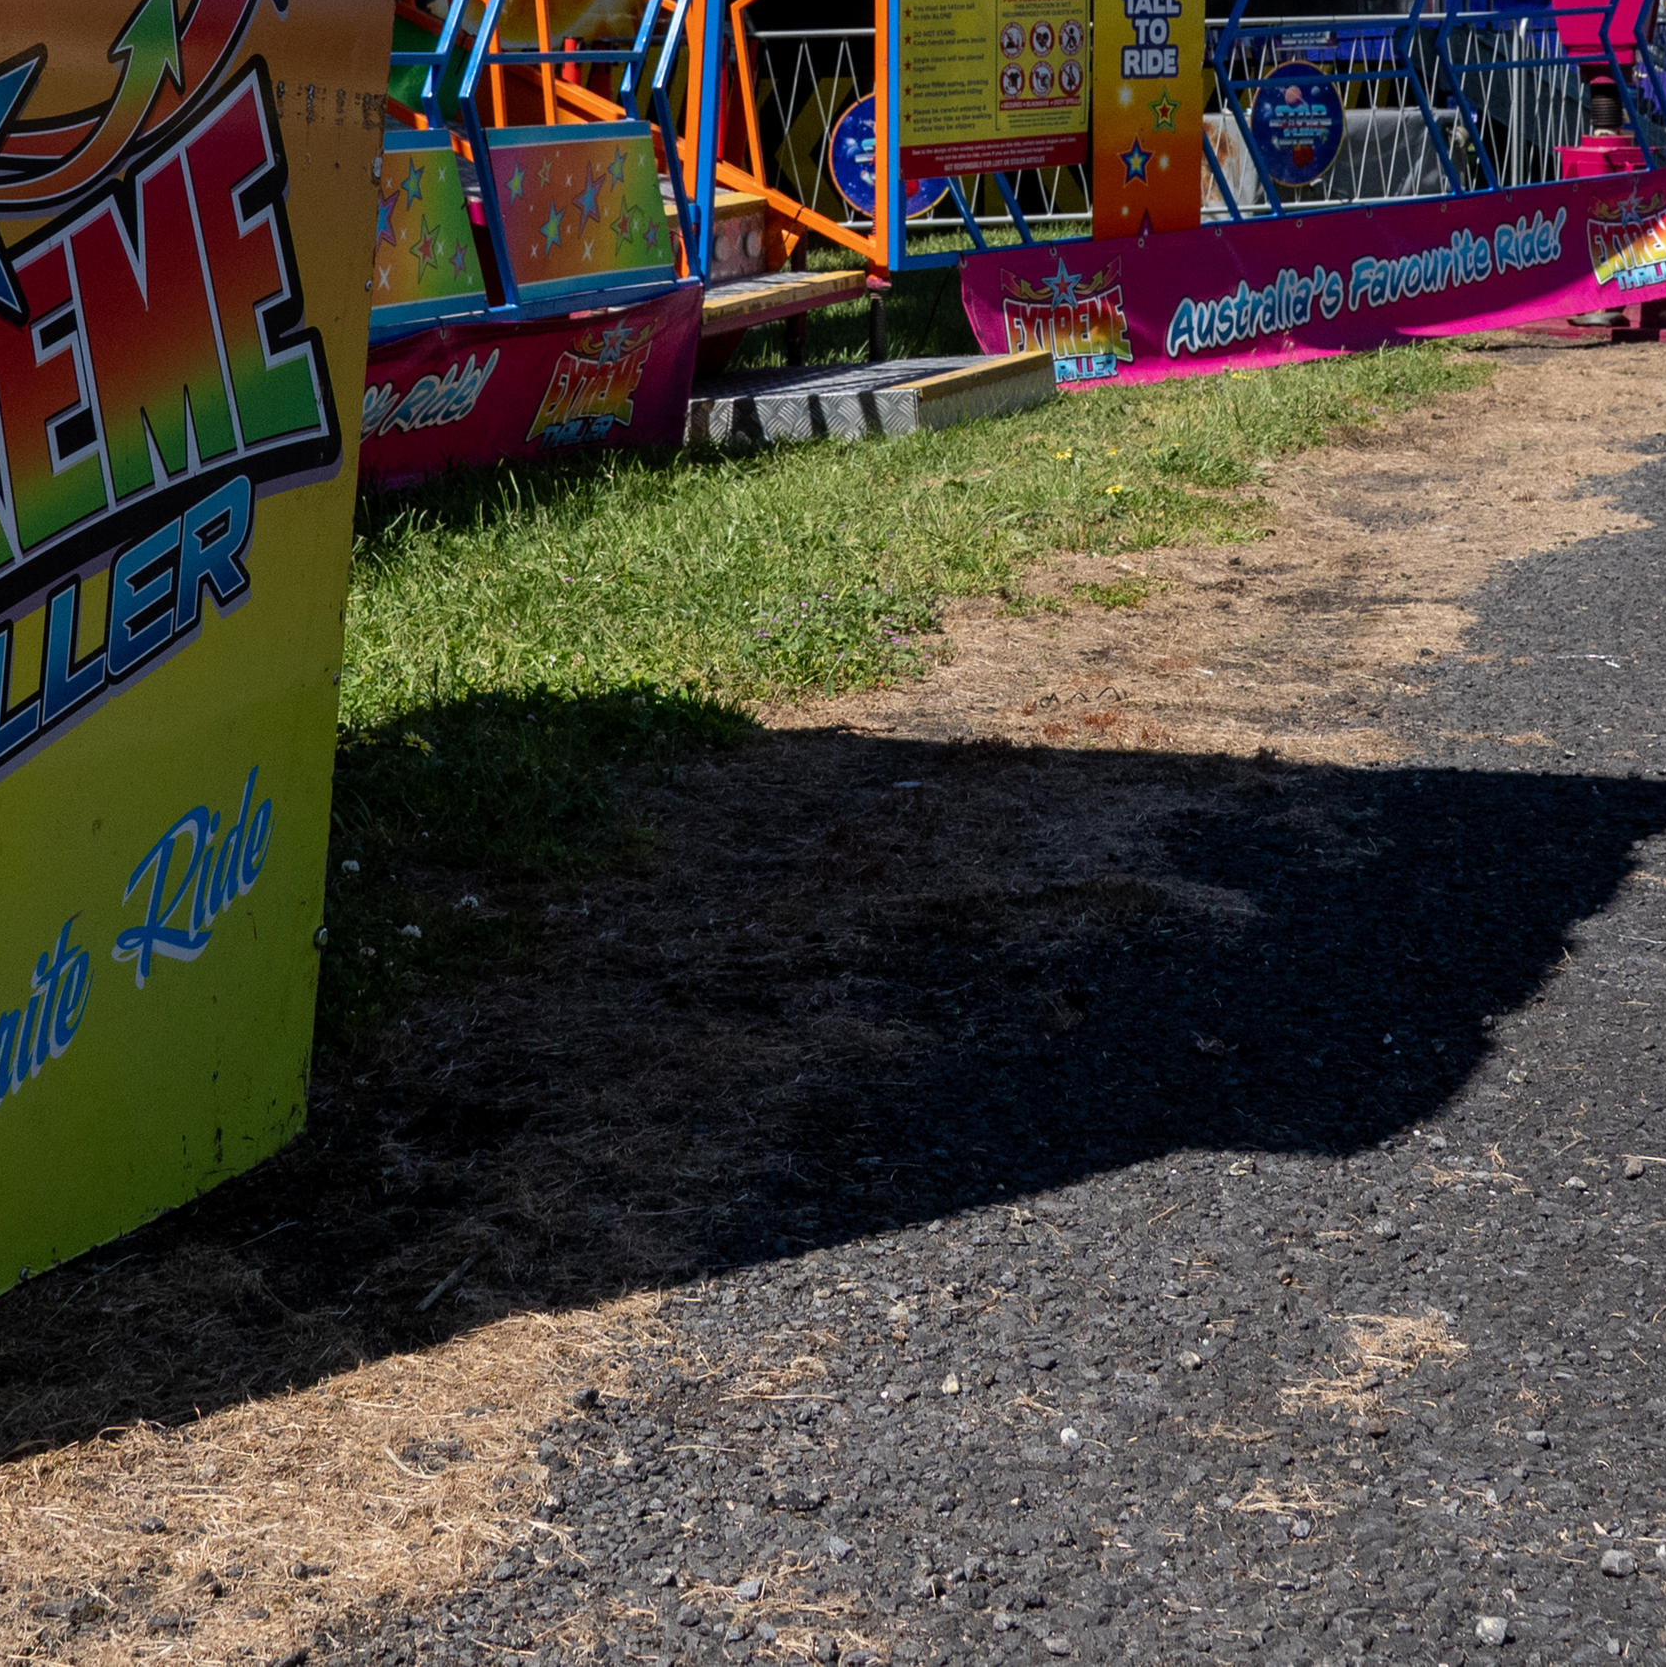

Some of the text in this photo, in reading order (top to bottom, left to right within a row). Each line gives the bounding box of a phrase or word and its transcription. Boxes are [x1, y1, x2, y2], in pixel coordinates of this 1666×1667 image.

[1122, 47, 1178, 76] RIDE
[1134, 18, 1168, 45] TO
[1002, 284, 1134, 362] EXTREME
[1165, 205, 1568, 358] Australia's Favourite Ride!
[379, 346, 500, 438] Ride!
[111, 764, 274, 990] Ride
